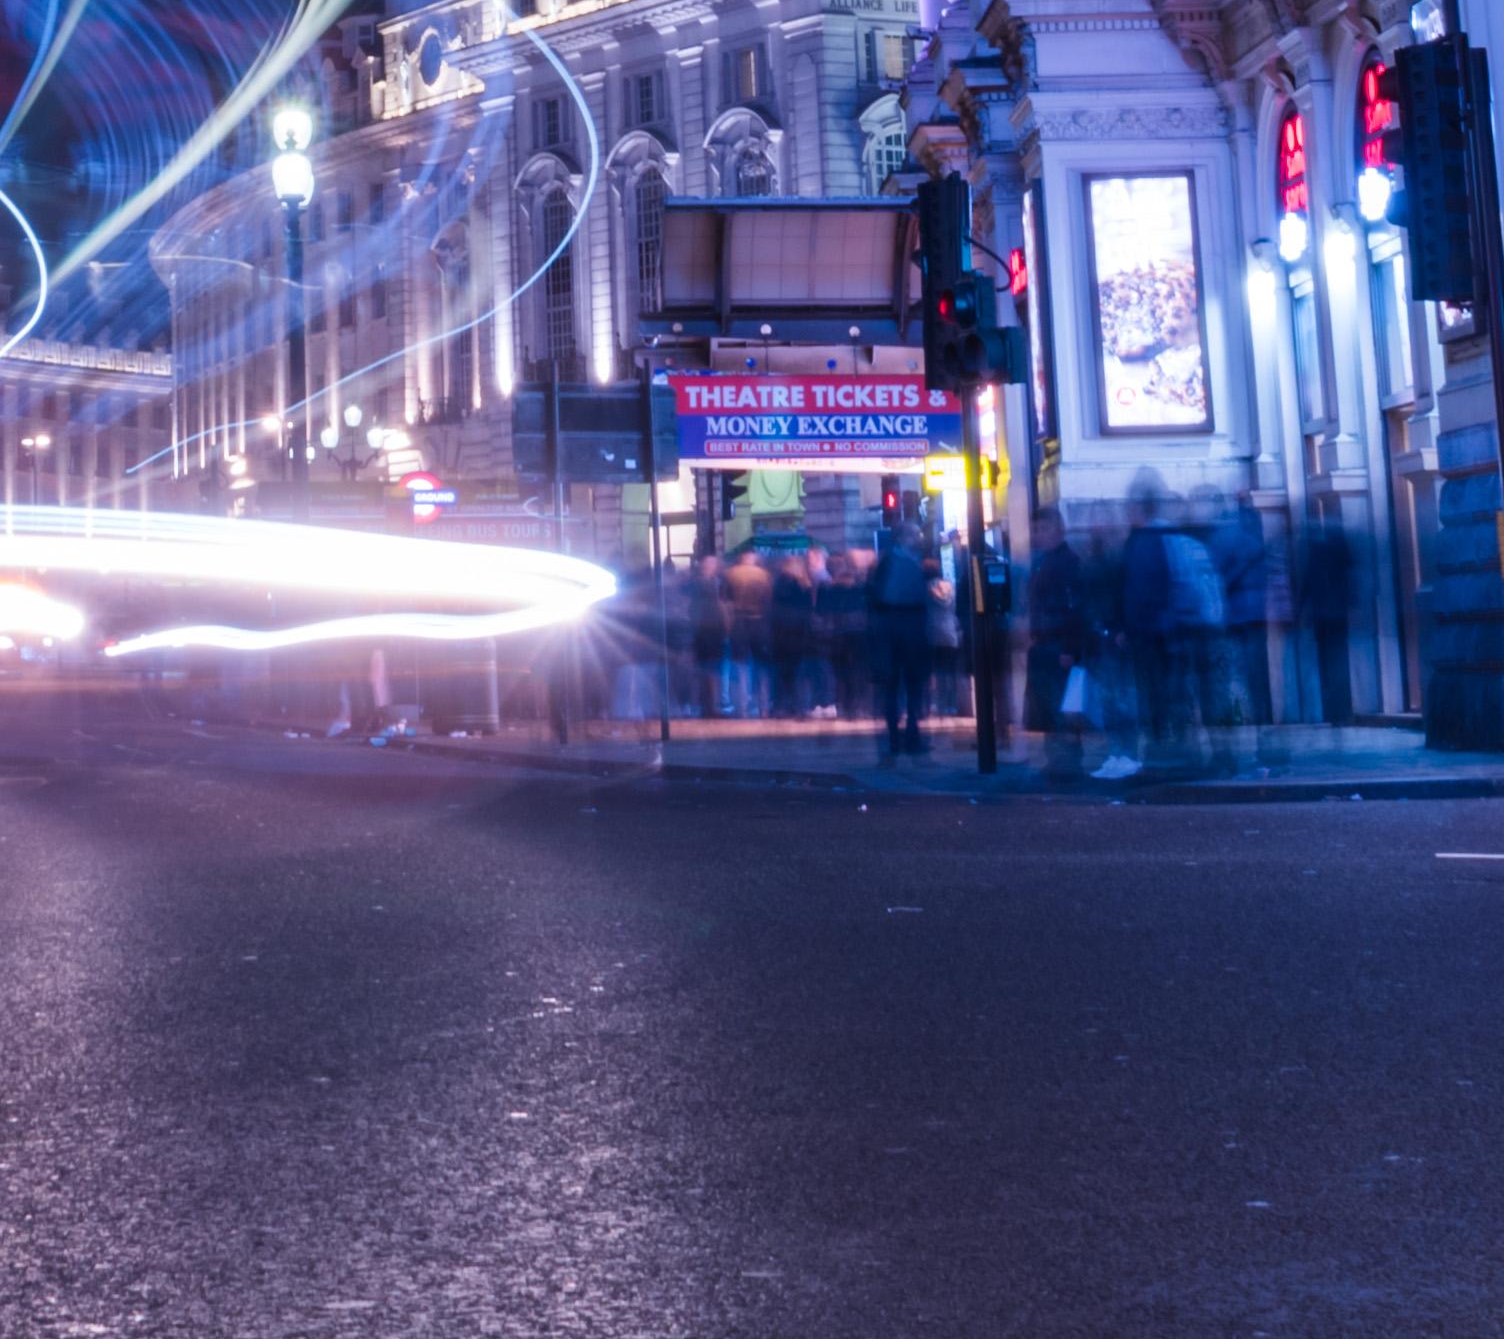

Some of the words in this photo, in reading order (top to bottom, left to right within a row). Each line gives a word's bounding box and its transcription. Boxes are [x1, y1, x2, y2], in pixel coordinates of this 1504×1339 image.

[894, 0, 918, 13] LIFE
[685, 384, 805, 408] THEATRE
[811, 384, 920, 407] TICKETS
[928, 389, 947, 406] &
[705, 416, 793, 436] MONEY
[797, 415, 928, 435] EXCHANGE
[709, 442, 739, 453] BEST
[742, 442, 771, 453] RATE
[773, 442, 784, 453] IN
[787, 442, 820, 453] TOWN
[835, 441, 851, 452] NO
[853, 441, 926, 453] COMMISSION
